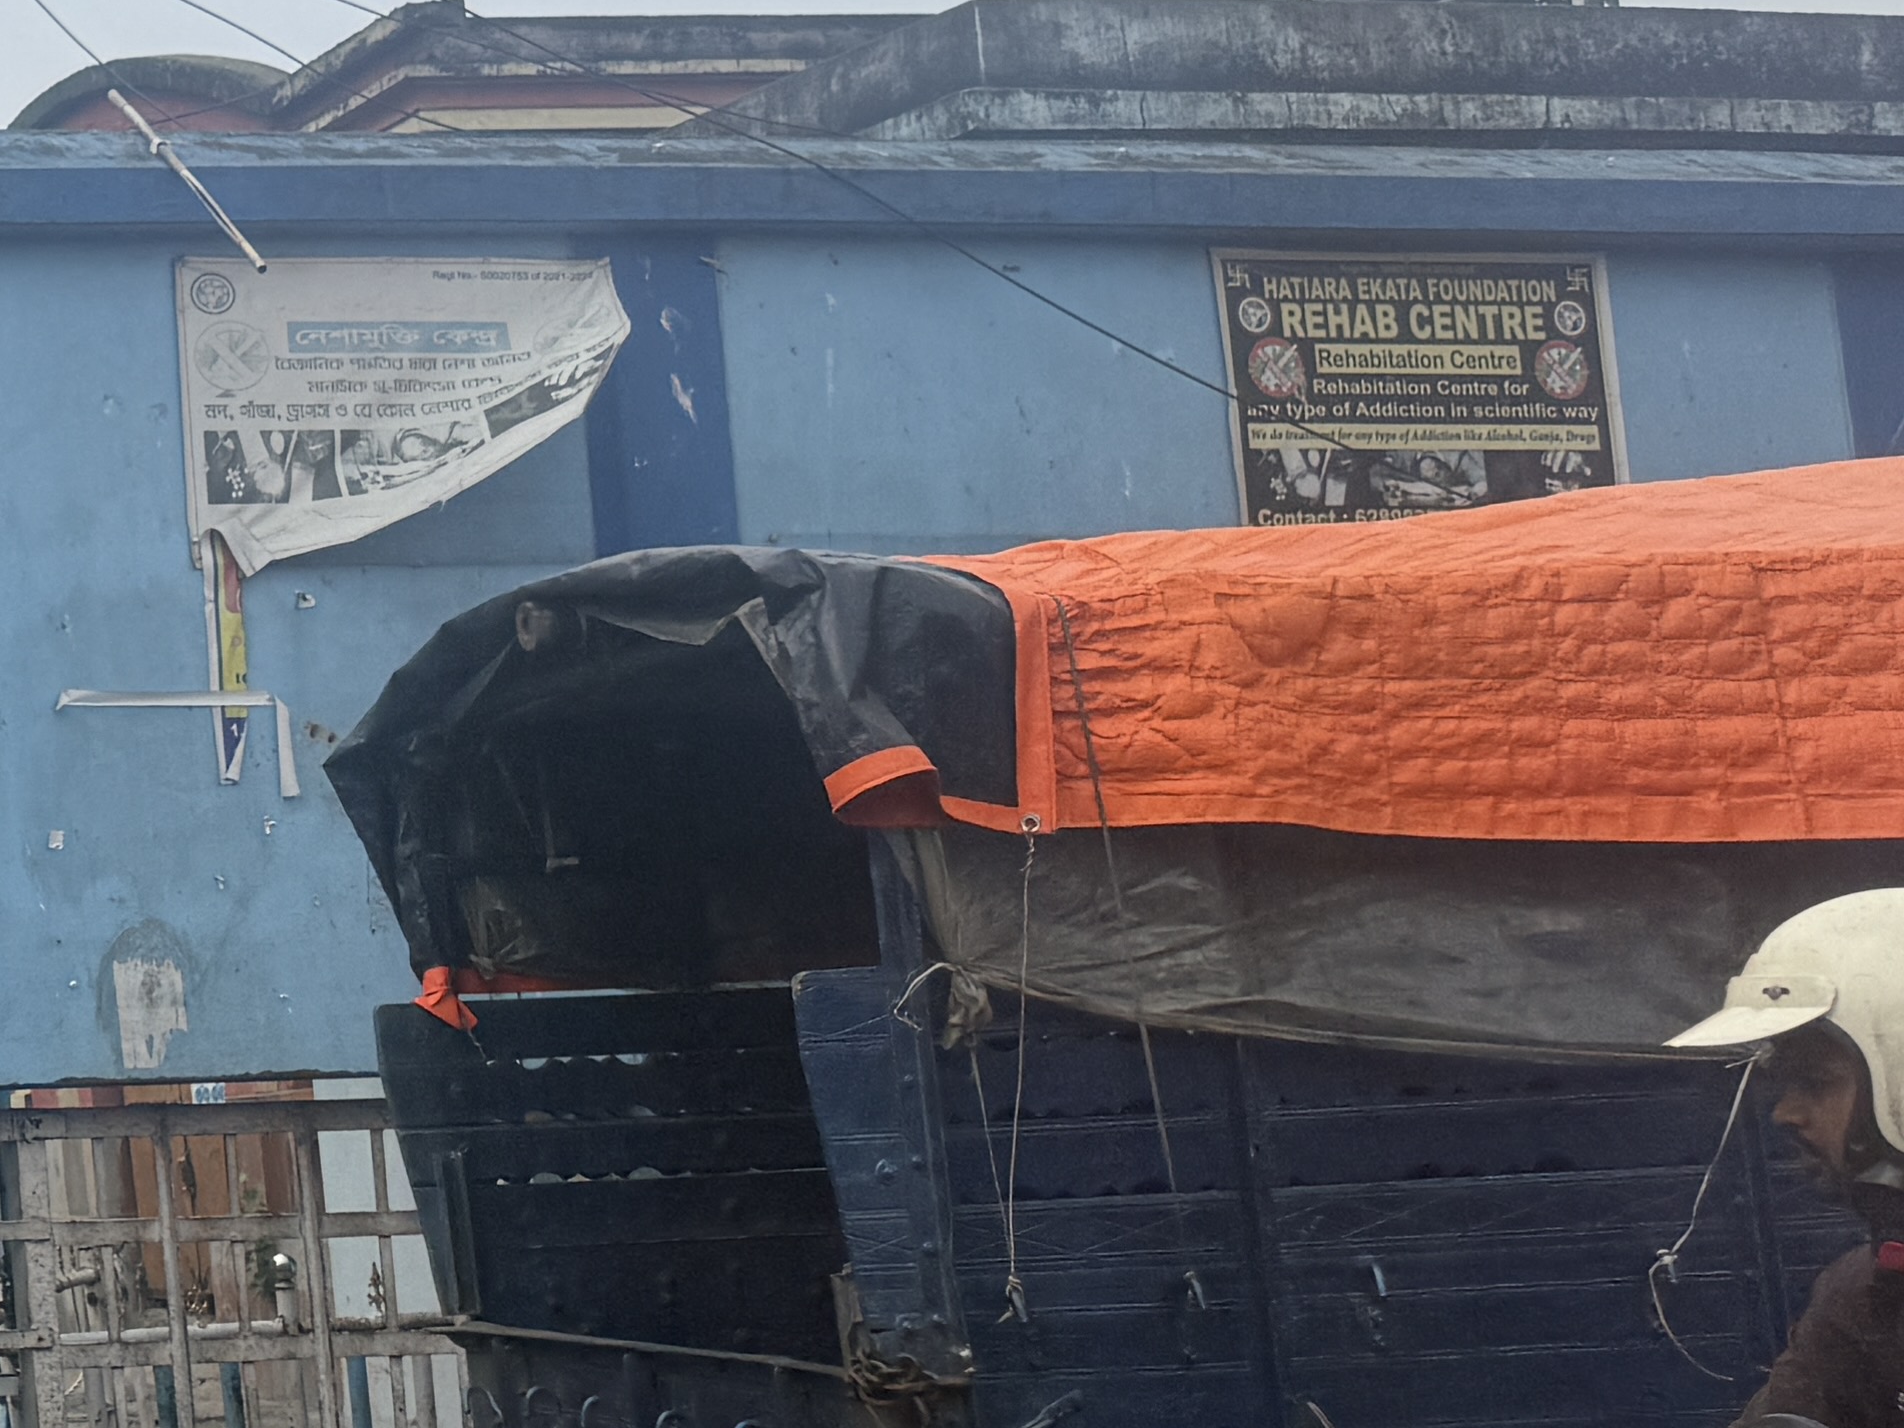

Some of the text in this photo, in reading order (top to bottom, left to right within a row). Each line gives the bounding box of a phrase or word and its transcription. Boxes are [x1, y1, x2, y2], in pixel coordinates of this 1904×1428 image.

[1263, 276, 1557, 302] HATIARA EKATA FOUNDATION
[1280, 302, 1546, 341] REHAB CENTRE
[1317, 348, 1518, 370] Rehabilitation Centre
[1312, 378, 1530, 396] Rehabilitation Centre for
[1247, 403, 1280, 420] any
[1286, 403, 1326, 421] type
[1332, 402, 1350, 417] of
[1355, 402, 1445, 417] Addiction
[1473, 403, 1557, 418] scientific
[1562, 406, 1599, 421] way
[1257, 508, 1337, 526] Contact
